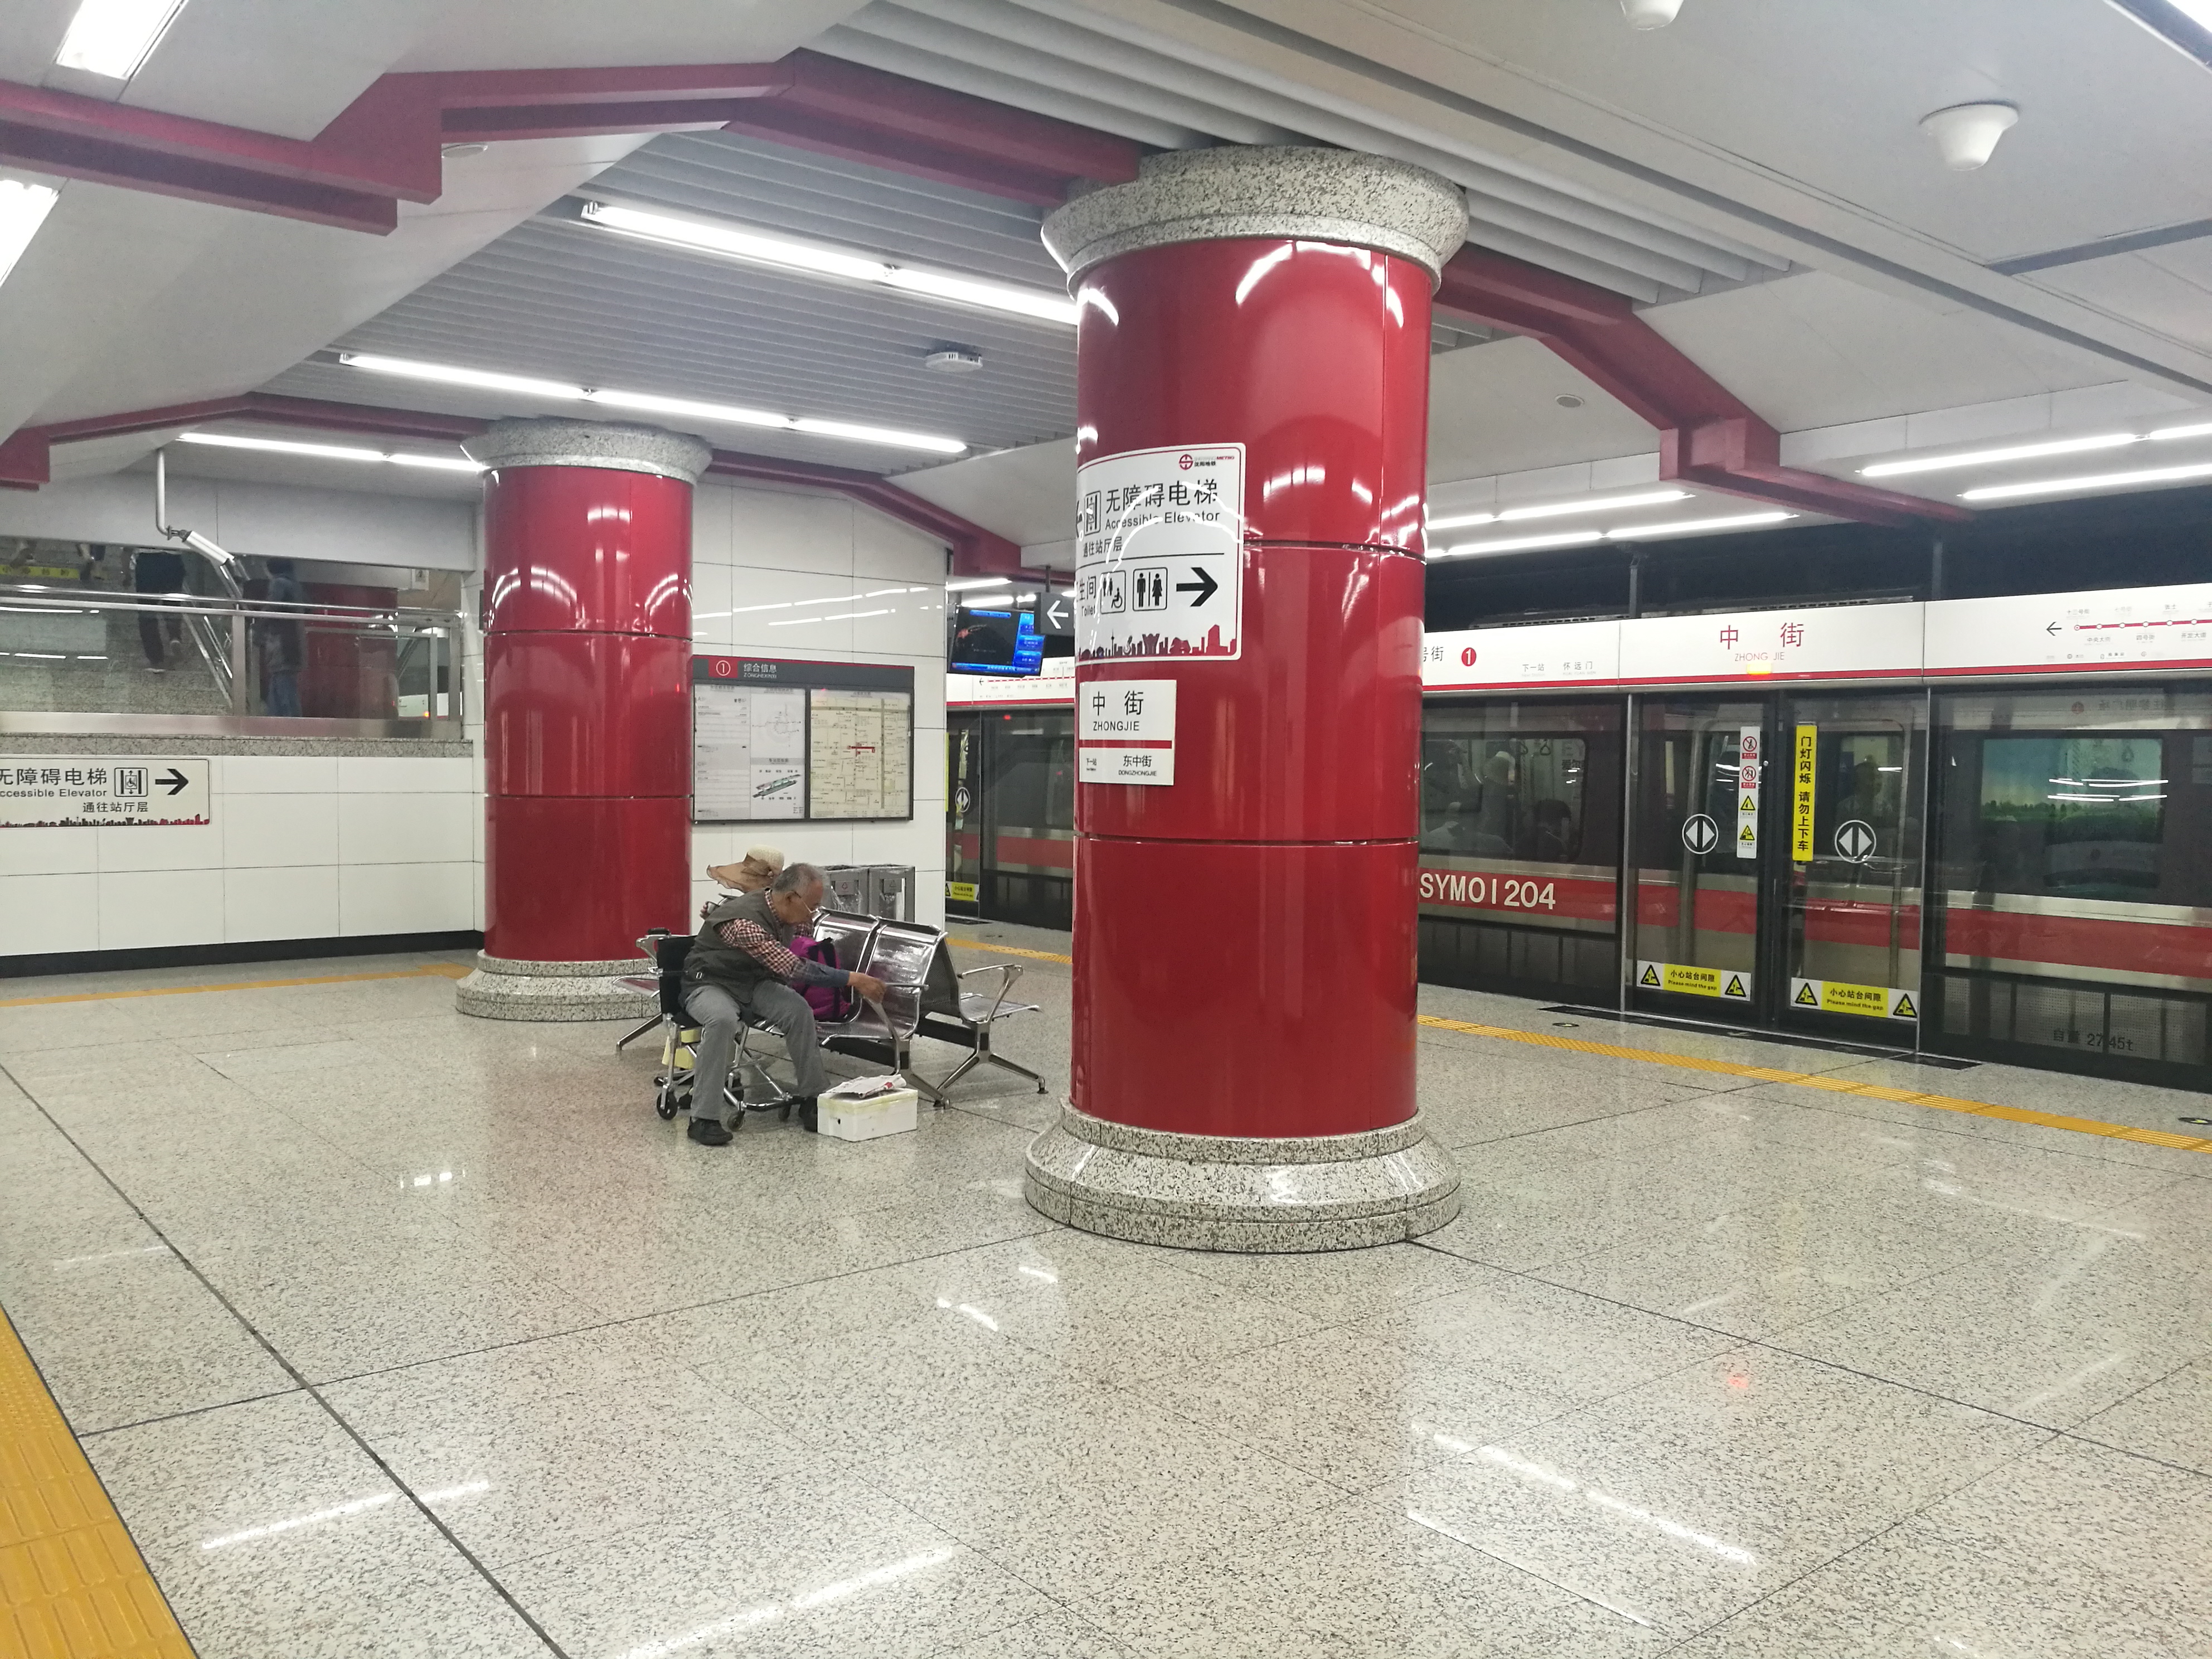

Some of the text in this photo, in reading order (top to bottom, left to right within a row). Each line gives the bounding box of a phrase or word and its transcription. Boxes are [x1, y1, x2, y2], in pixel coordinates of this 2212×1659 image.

[1106, 479, 1217, 514] 无障碍电梯
[1720, 622, 1804, 650] 中街
[1735, 652, 1785, 662] ZHONG JIE
[743, 663, 777, 673] 综合信息
[1522, 663, 1545, 672] 下一站
[1563, 661, 1593, 671] 怀远门
[1093, 690, 1144, 716] 中街
[1093, 721, 1140, 731] ZHONGJIE
[1123, 755, 1152, 768] 东中街
[0, 768, 107, 785] 无障碍电梯
[59, 789, 107, 797] Elevator
[1797, 736, 1812, 851] 门灯闪烁 请勿上下车
[83, 802, 149, 813] 通往站厅层
[1671, 969, 1715, 982] 小心站台间隙
[1830, 988, 1881, 1002] 小心站台间隙
